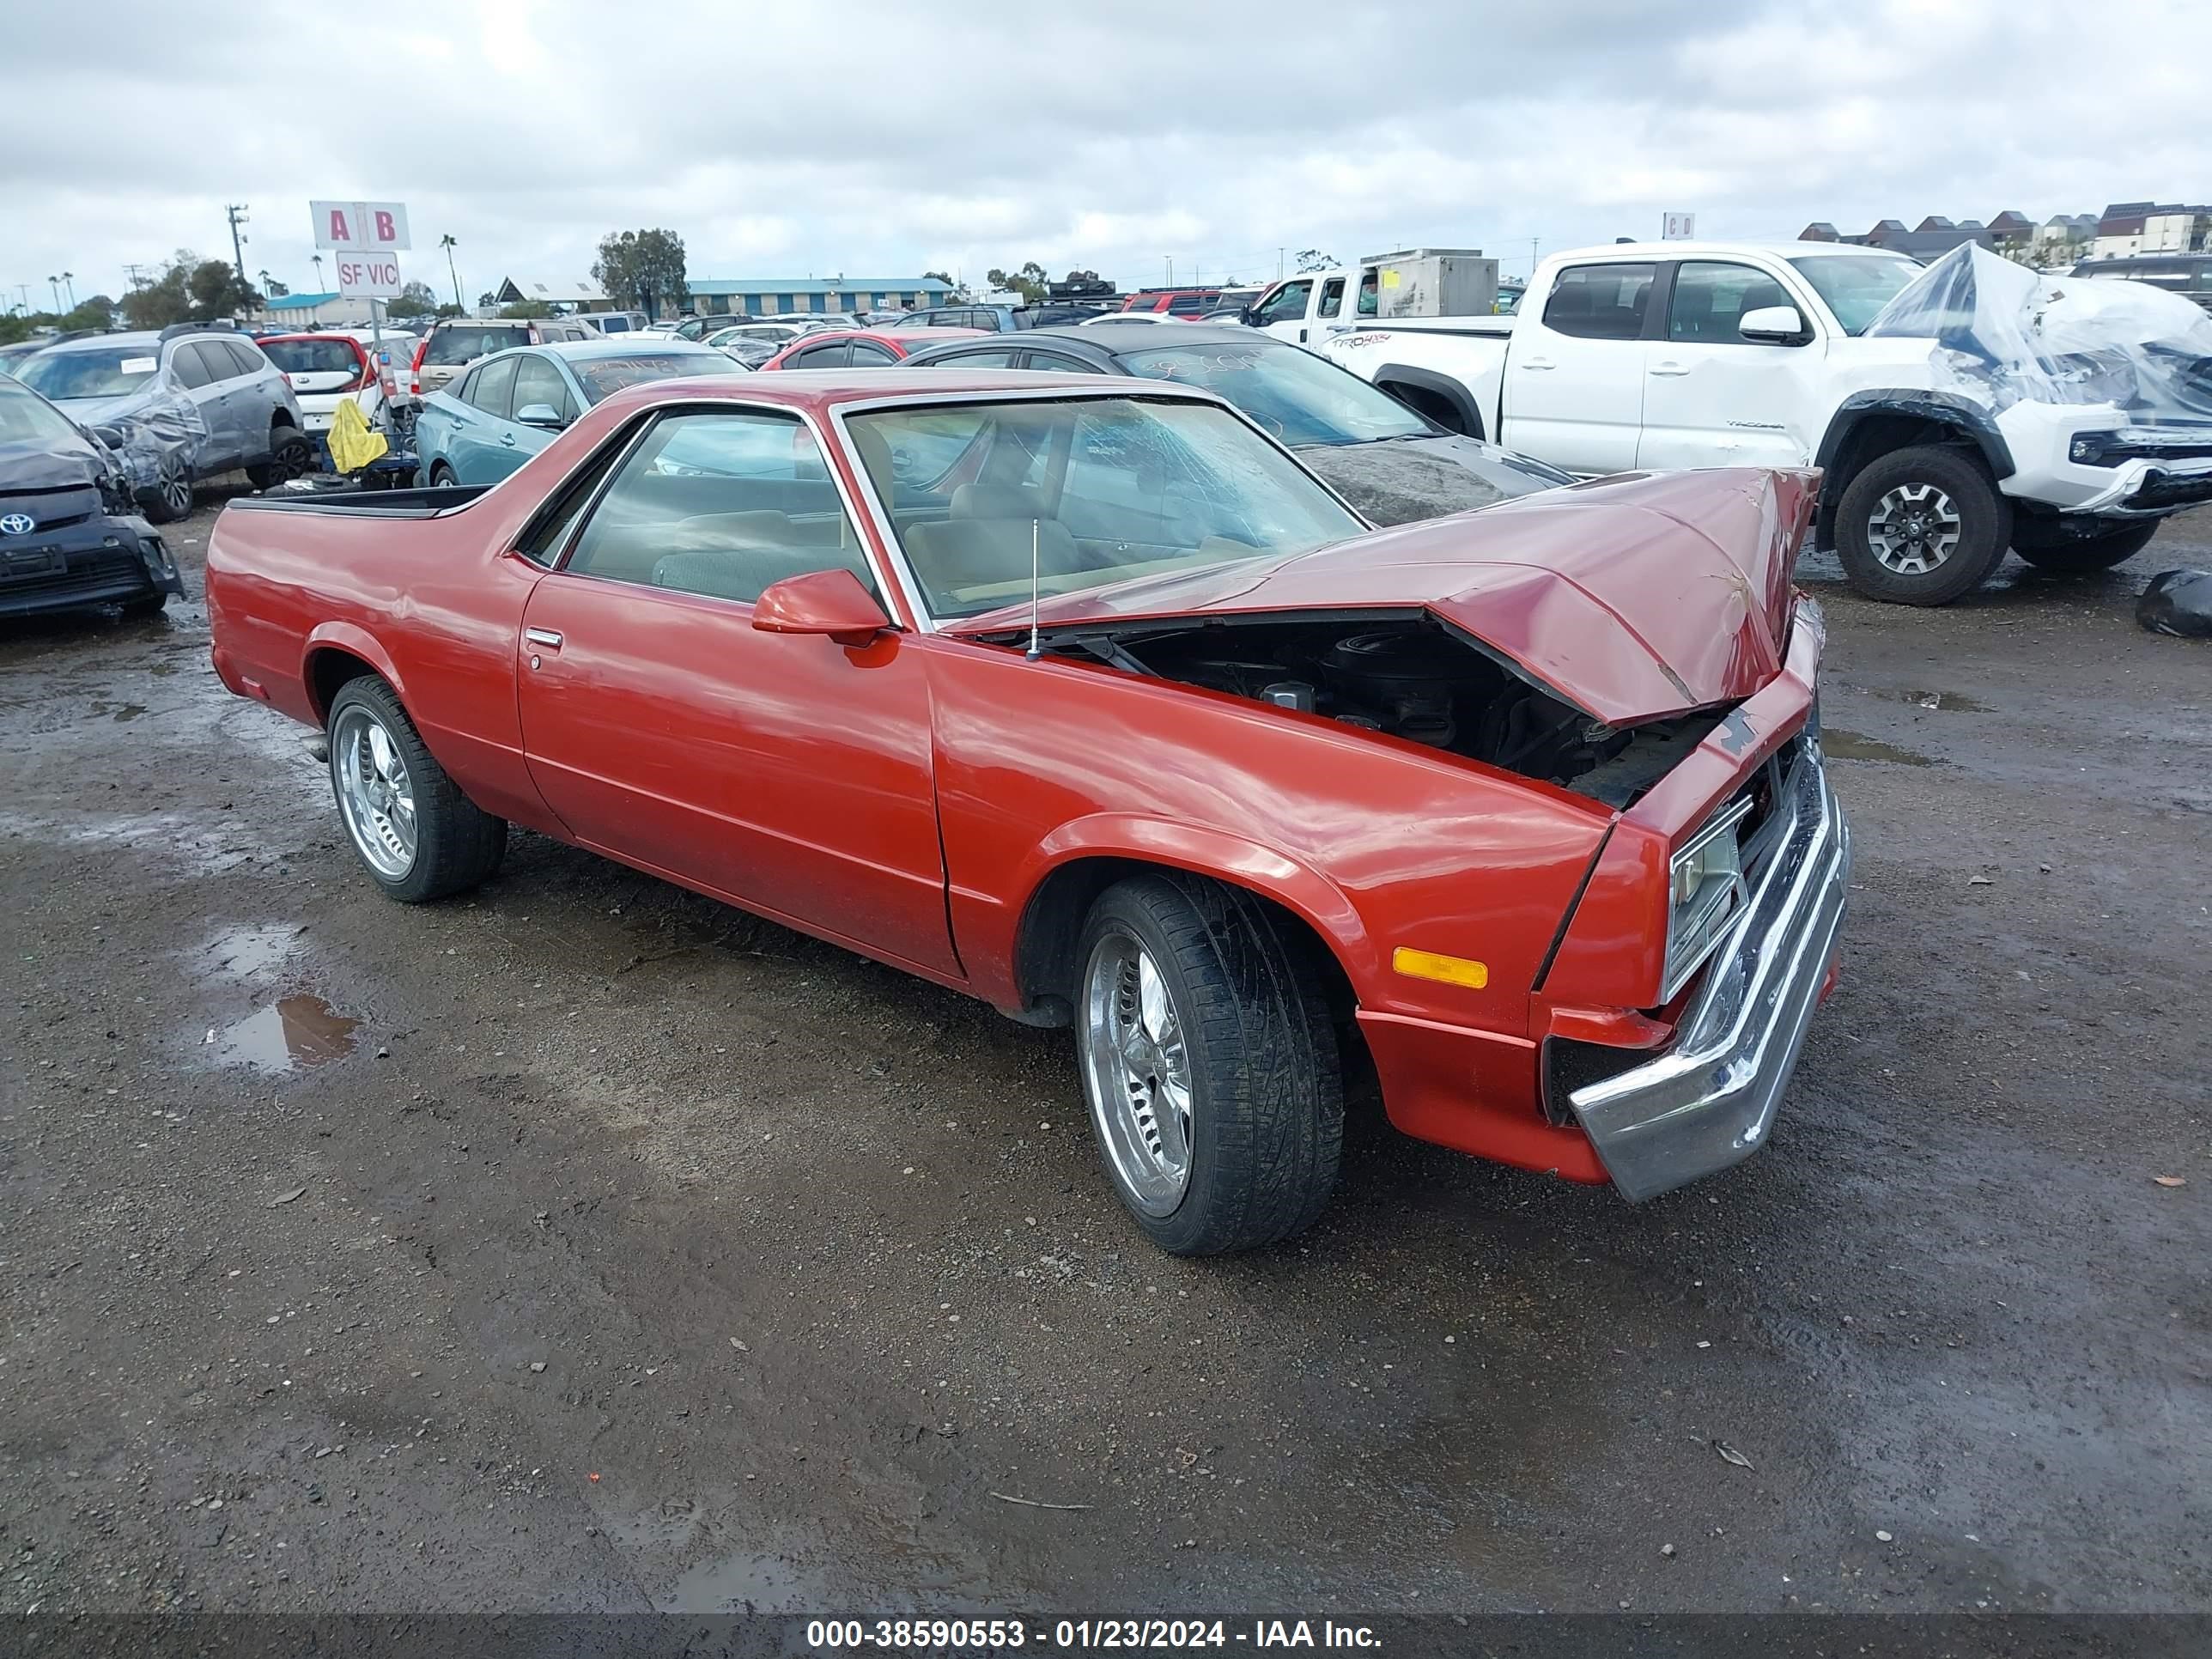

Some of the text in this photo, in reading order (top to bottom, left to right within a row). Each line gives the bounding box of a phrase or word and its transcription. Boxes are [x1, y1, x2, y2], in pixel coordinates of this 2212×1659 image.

[331, 210, 396, 241] A B
[1669, 217, 1676, 234] C
[341, 264, 397, 285] SF VIC
